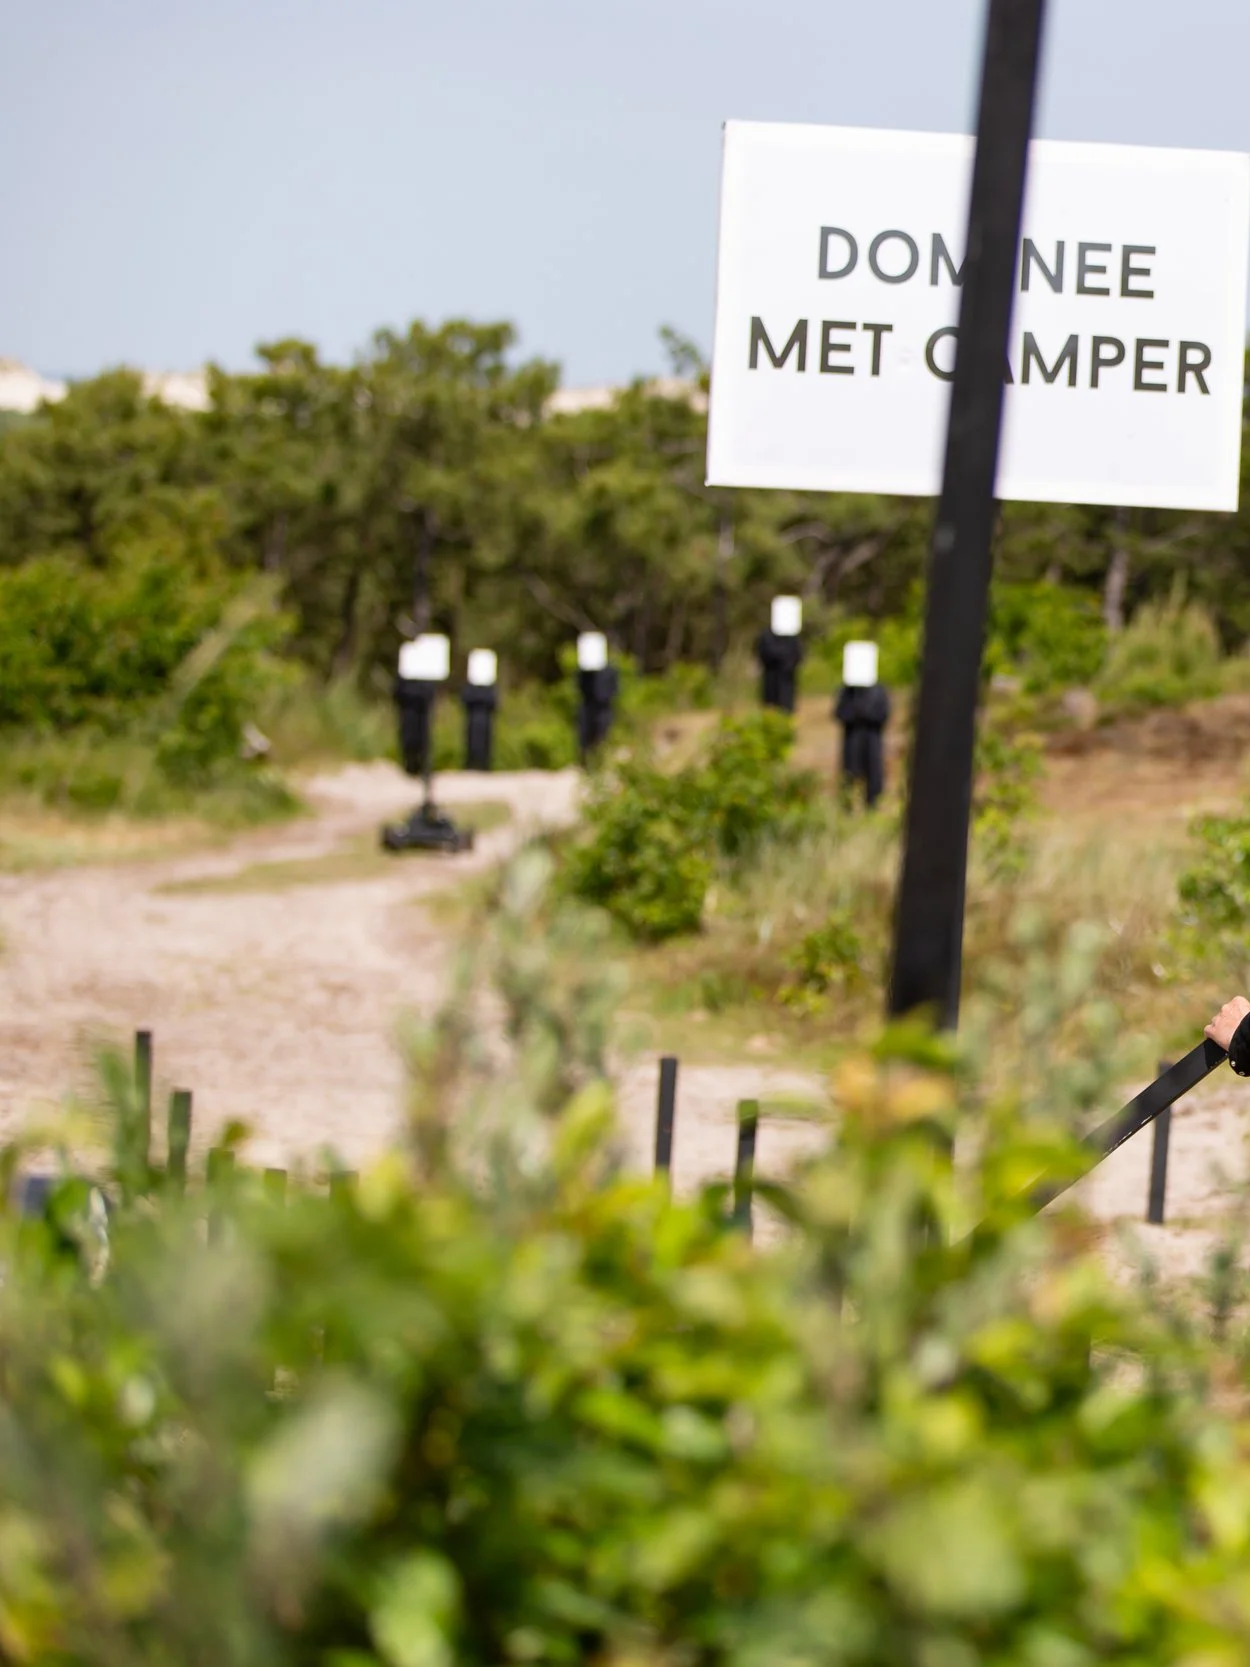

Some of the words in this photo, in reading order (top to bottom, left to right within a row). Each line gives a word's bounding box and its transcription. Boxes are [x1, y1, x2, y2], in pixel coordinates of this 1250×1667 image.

[818, 225, 1157, 300] DOMNEE
[748, 315, 894, 377] MET
[925, 325, 1213, 396] CMPER
